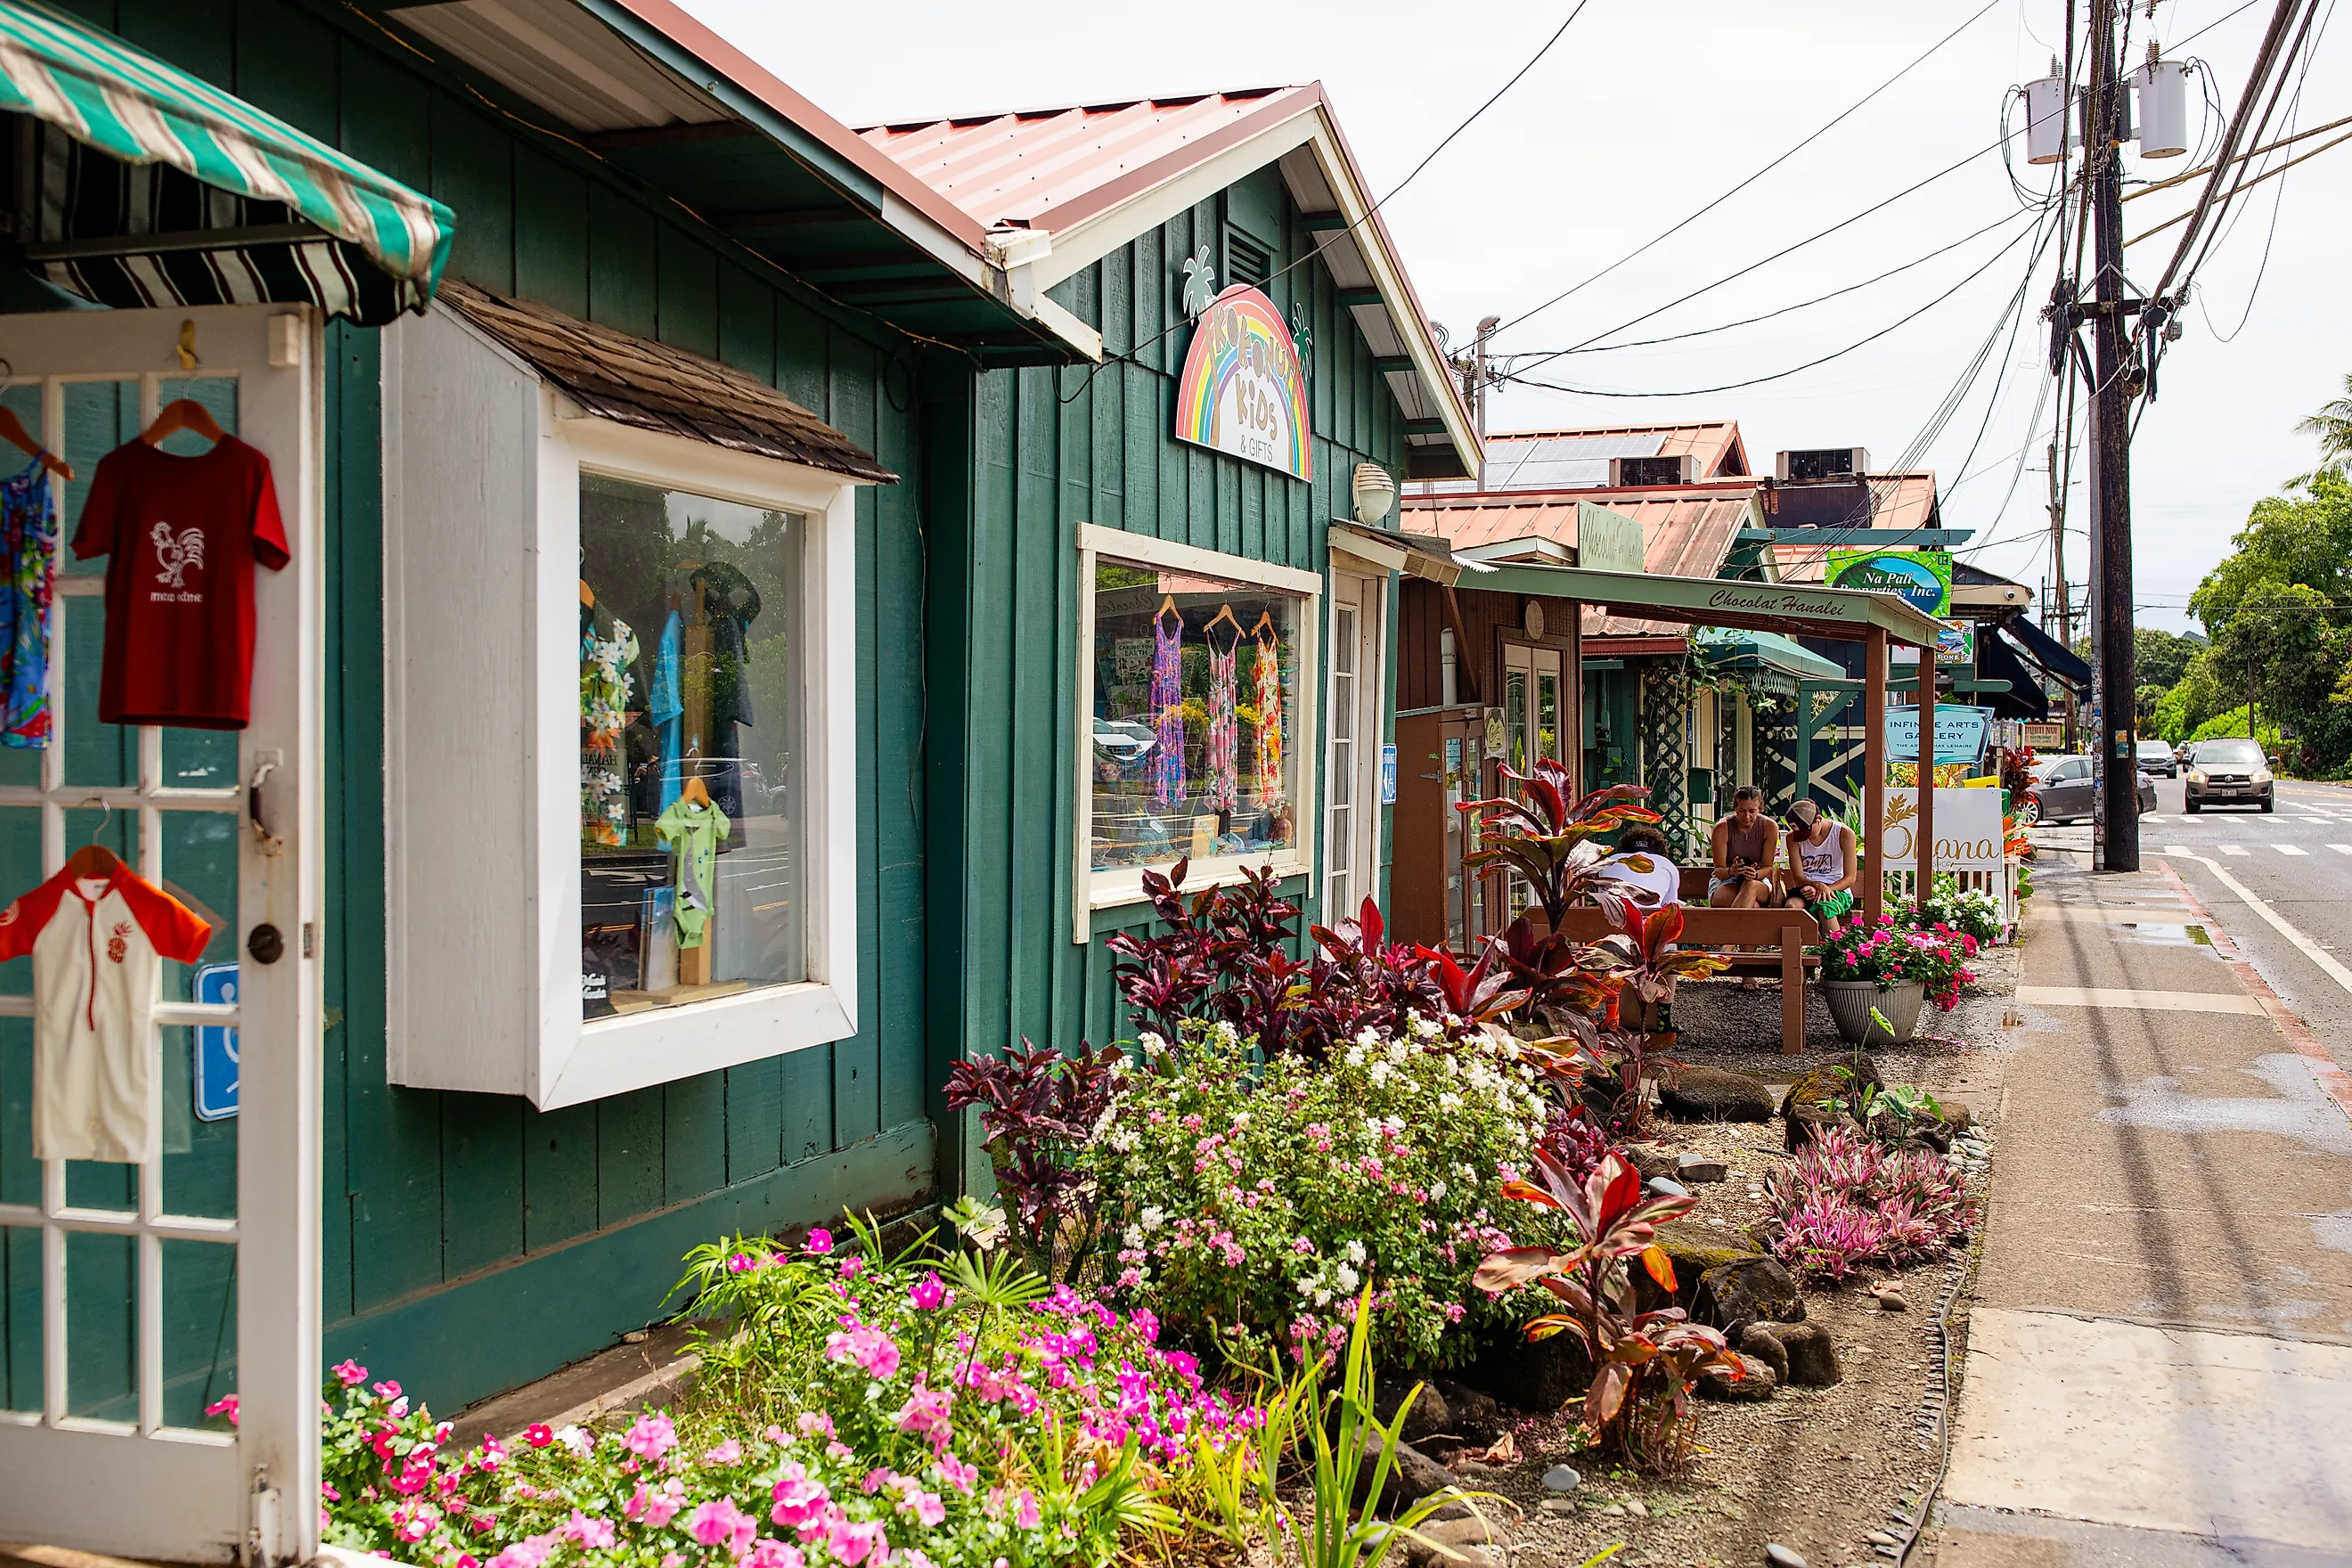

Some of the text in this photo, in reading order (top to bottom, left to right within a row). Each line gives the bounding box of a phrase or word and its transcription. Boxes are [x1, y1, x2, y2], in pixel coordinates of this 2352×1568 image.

[1213, 300, 1295, 393] KOKONUT
[1240, 434, 1273, 462] & GIFTS
[1863, 572, 1913, 584] Na Pali
[1910, 584, 1936, 597] Inc.
[1709, 590, 1846, 616] Chocolat Hanalei
[2046, 726, 2058, 735] NUI
